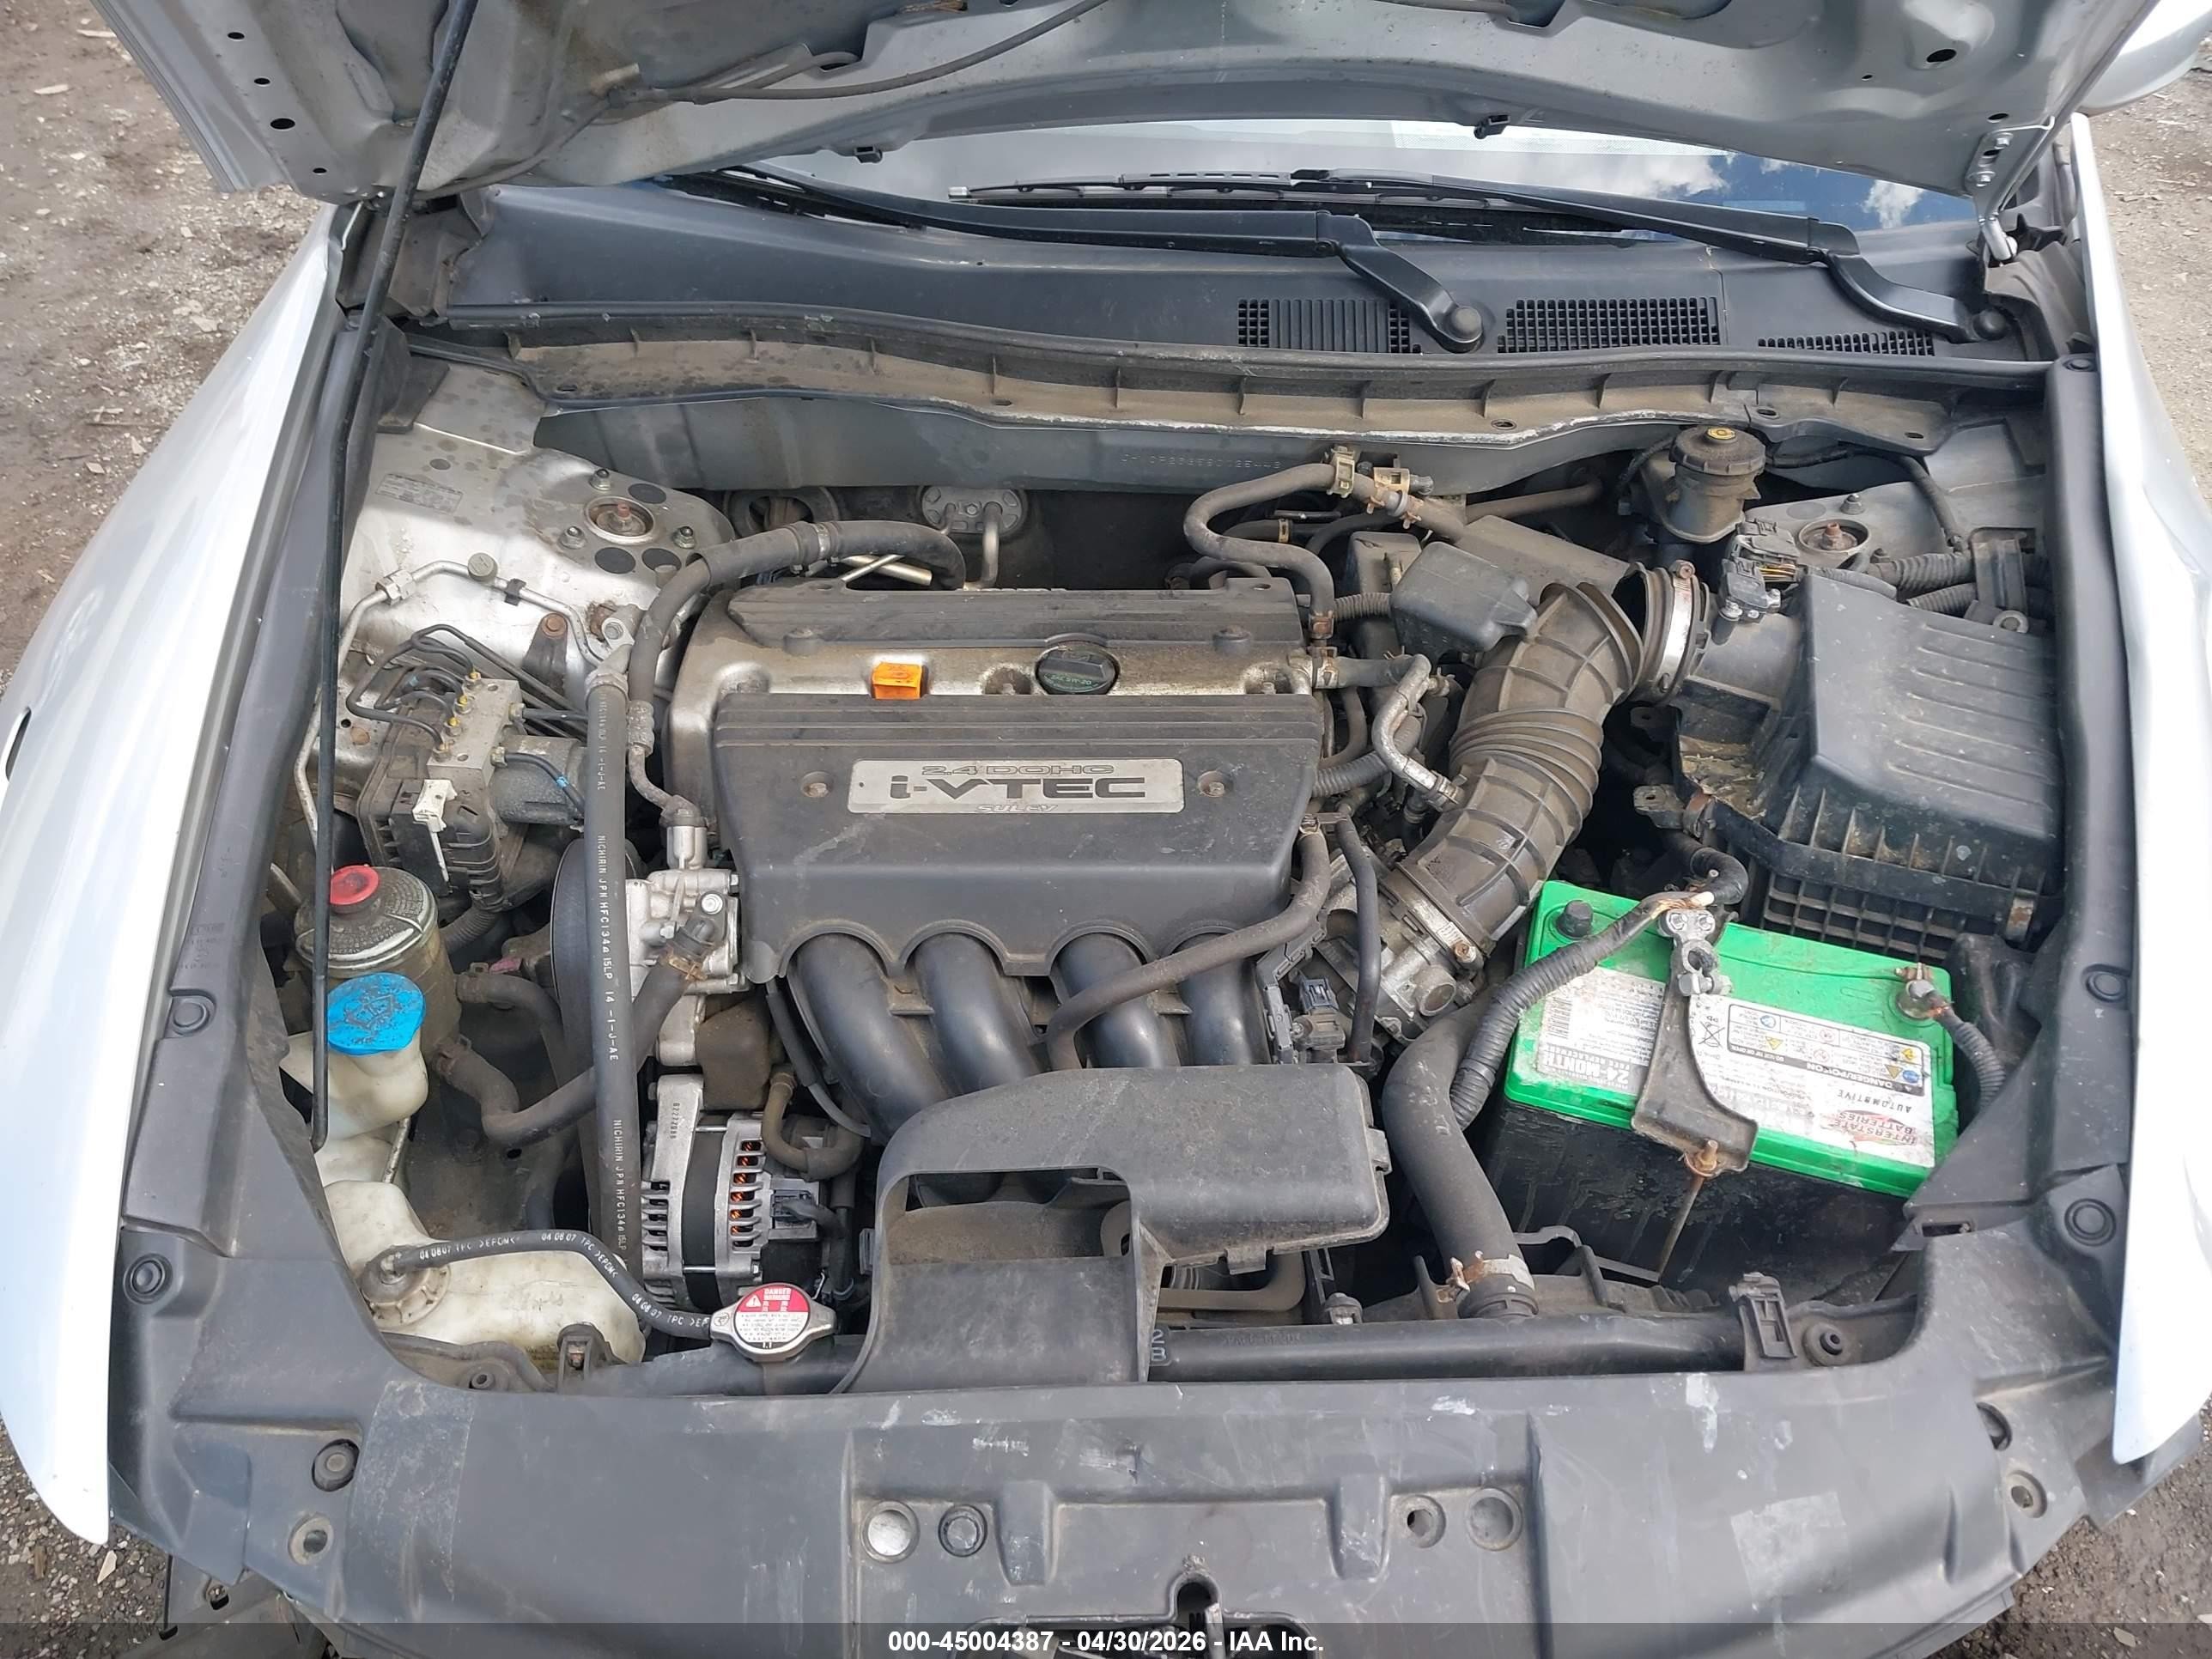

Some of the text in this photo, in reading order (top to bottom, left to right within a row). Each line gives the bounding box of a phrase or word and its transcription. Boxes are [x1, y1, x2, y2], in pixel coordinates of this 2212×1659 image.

[921, 764, 1115, 775] 2.4 DOHC
[889, 775, 1146, 799] i-VTEC
[597, 835, 608, 874] NICHIRIN
[597, 878, 607, 899] JPN
[1541, 1051, 1632, 1085] 24-MONTH
[1832, 1119, 1917, 1146] INTERSTATE
[1838, 1110, 1913, 1134] BATTERIES
[613, 1119, 623, 1162] NICHIRIN
[614, 1165, 624, 1186] JPN
[667, 1314, 684, 1326] TPC
